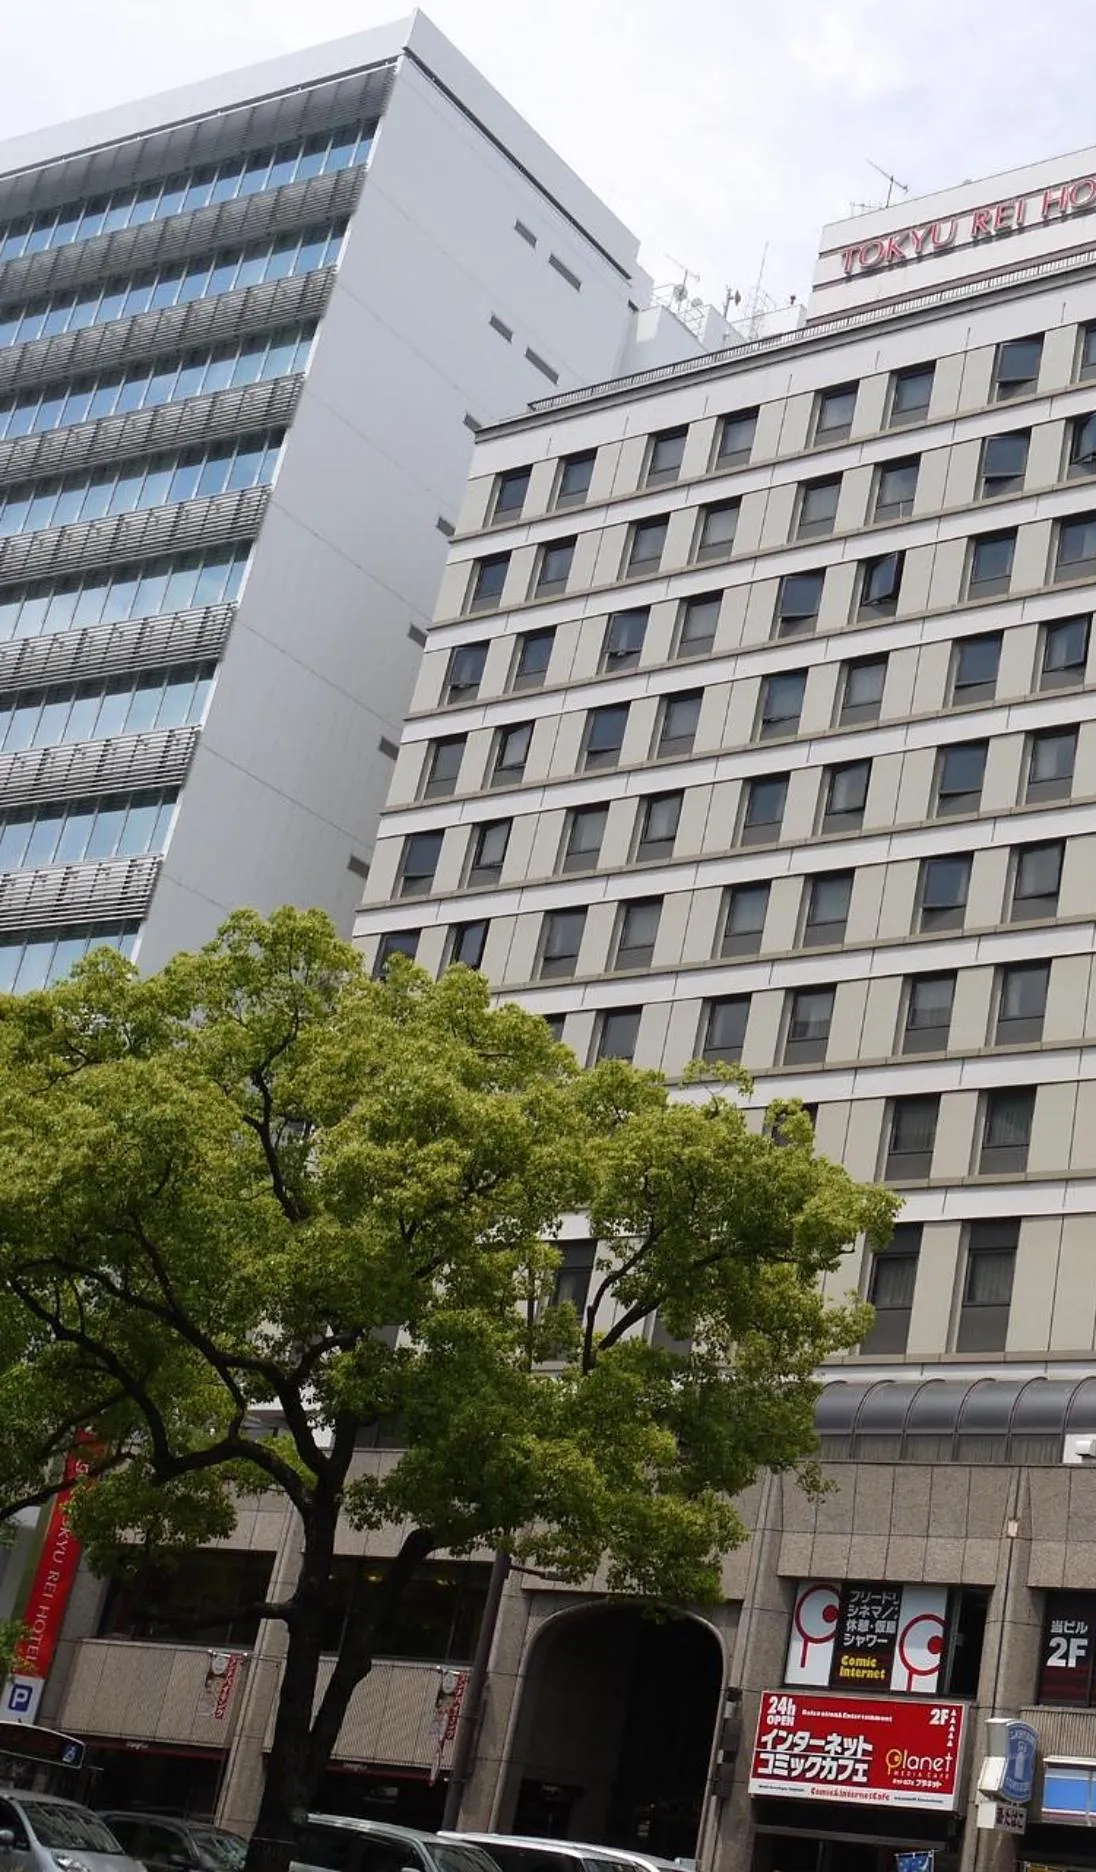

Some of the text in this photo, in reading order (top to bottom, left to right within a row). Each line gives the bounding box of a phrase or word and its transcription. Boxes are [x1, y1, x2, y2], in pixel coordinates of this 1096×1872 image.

[841, 217, 959, 275] TOKYU
[971, 198, 1027, 239] REI
[43, 1570, 61, 1600] REI
[843, 1633, 889, 1648] シャワー
[841, 1655, 878, 1667] Comic
[1046, 1637, 1089, 1668] 2F
[839, 1666, 887, 1680] Internet
[767, 1696, 797, 1717] 24h
[929, 1708, 950, 1725] 2F
[766, 1715, 795, 1727] OPEN
[760, 1728, 874, 1759] インターネット
[757, 1752, 870, 1784] コミックカフェ
